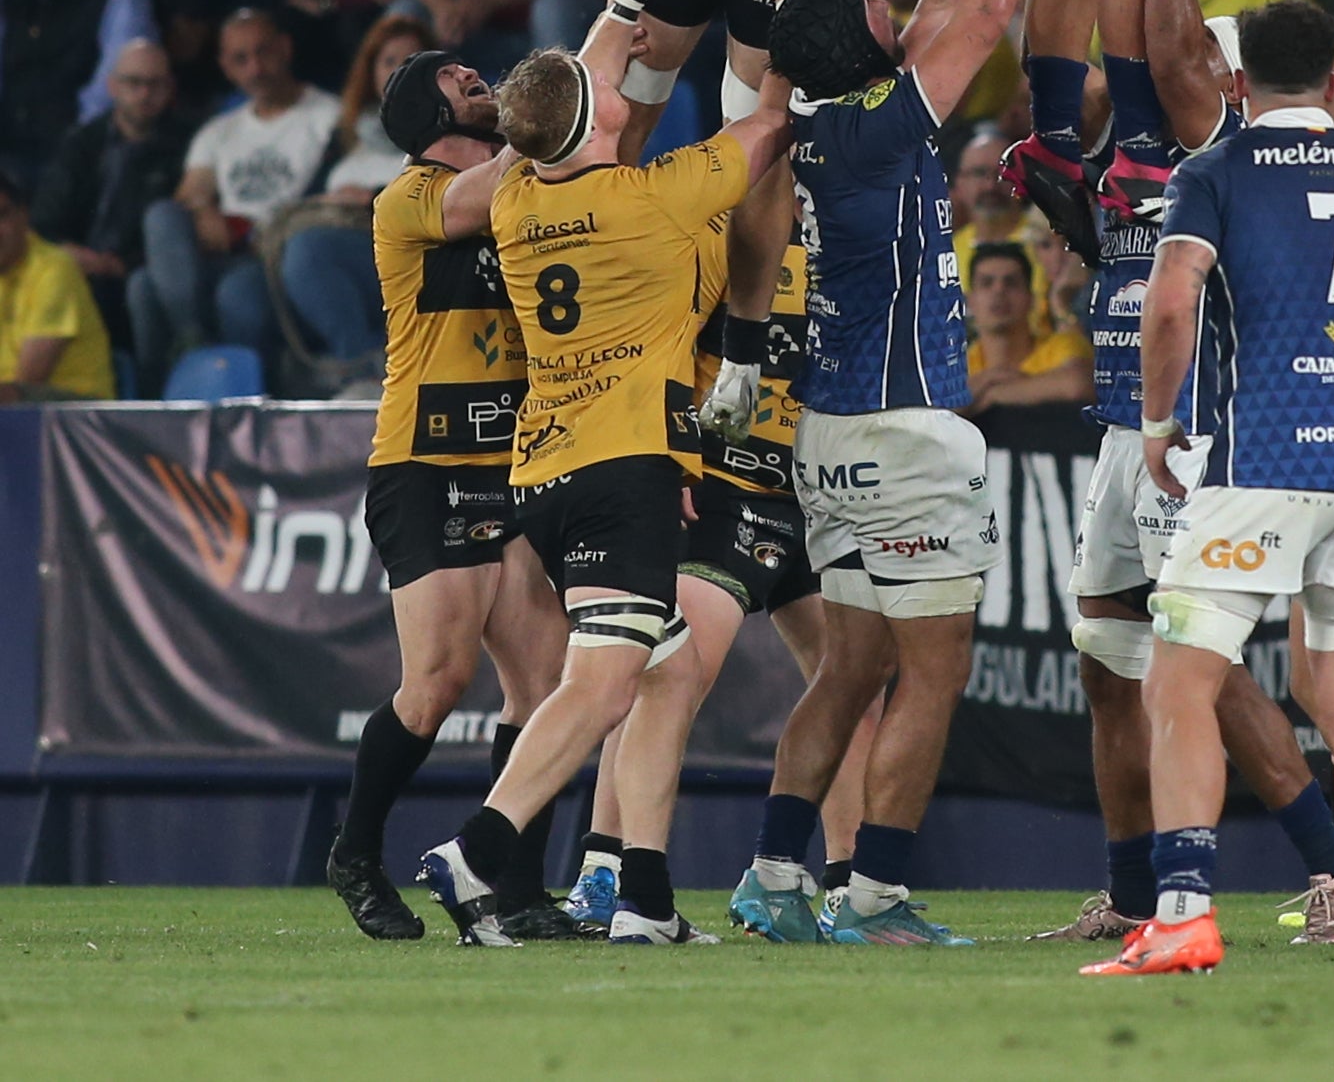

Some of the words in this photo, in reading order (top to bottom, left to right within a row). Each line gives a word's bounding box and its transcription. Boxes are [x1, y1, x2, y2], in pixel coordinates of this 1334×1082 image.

[527, 212, 598, 242] itesal
[535, 263, 581, 335] 8
[590, 342, 644, 364] LEÓN
[460, 490, 505, 502] ferroplas
[893, 535, 950, 558] cyltv
[1201, 538, 1266, 572] GO
[1260, 531, 1282, 550] fit
